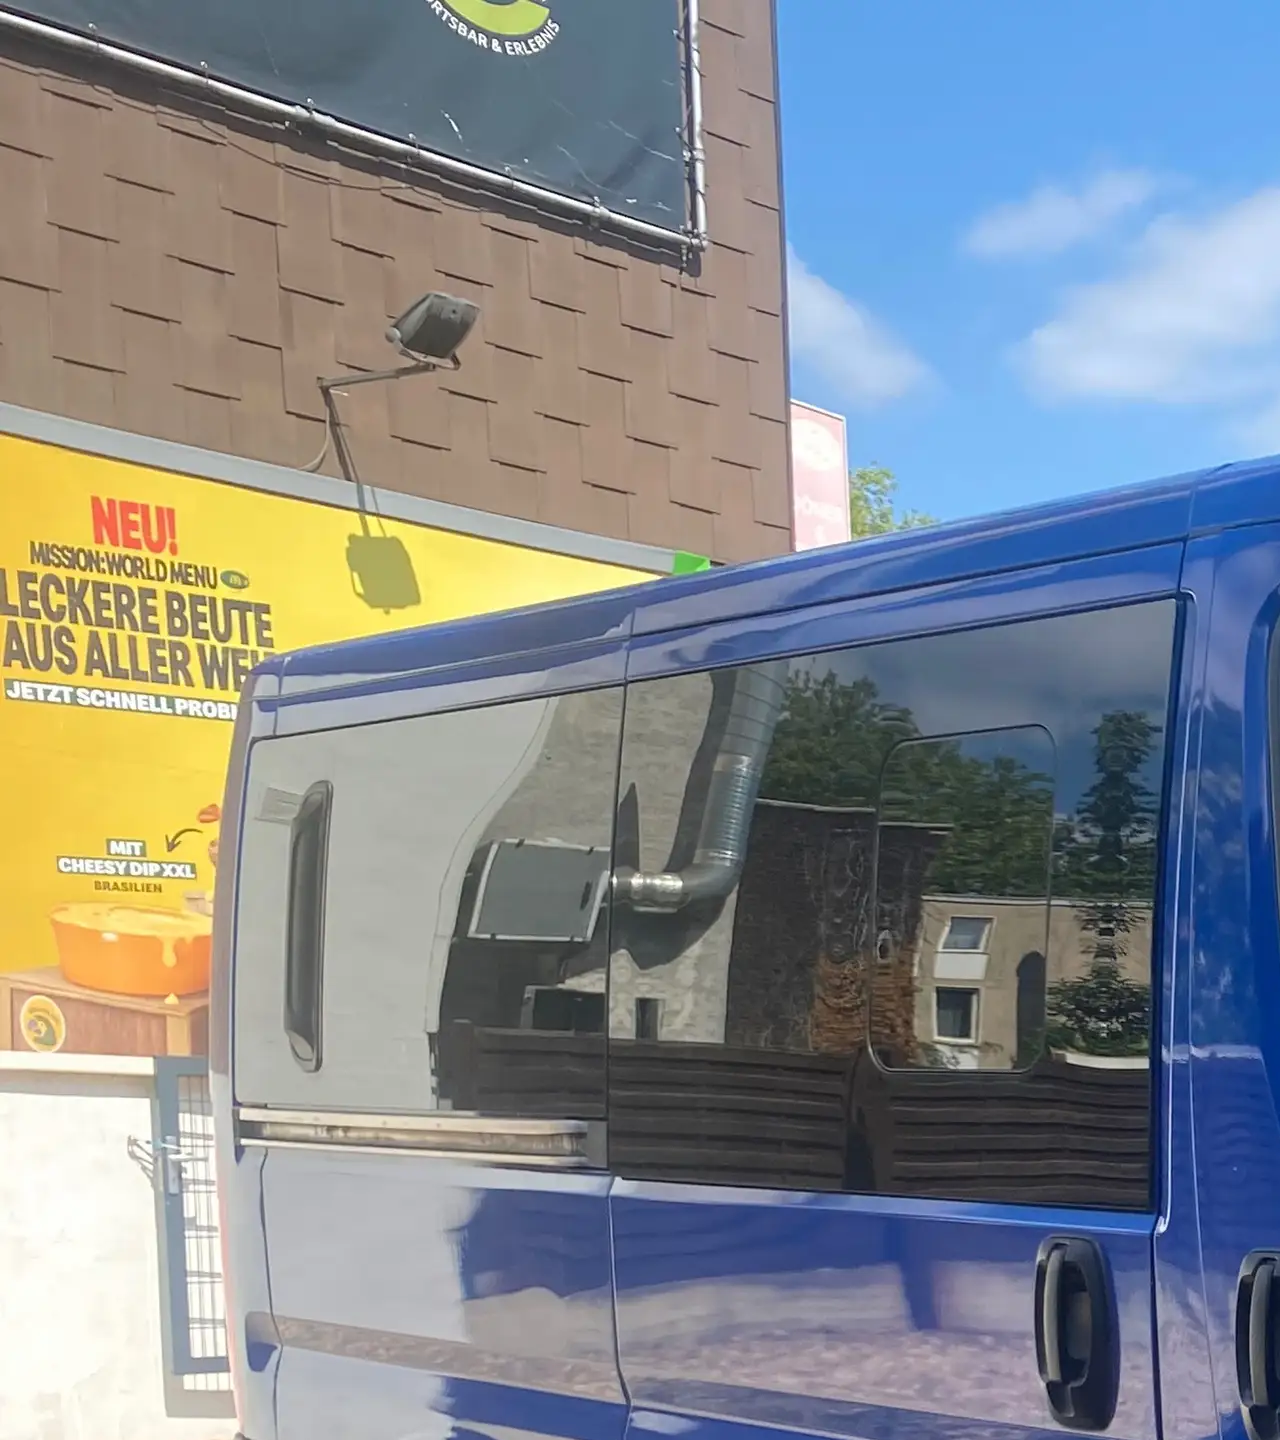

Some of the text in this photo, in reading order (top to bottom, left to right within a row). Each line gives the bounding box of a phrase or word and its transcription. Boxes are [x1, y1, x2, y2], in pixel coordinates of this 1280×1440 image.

[491, 38, 503, 53] &
[504, 19, 560, 56] ERLEBNIS
[90, 495, 178, 556] NEU!
[170, 560, 217, 589] MENU
[0, 567, 275, 648] LECKERE BEUTE
[3, 620, 277, 692] AUS ALLER WE
[6, 680, 74, 703] JETZT
[76, 687, 173, 714] SCHNELL
[109, 840, 143, 856] MIT
[58, 858, 196, 878] CHEESY DIP XXL
[94, 880, 163, 893] BRASILIEN
